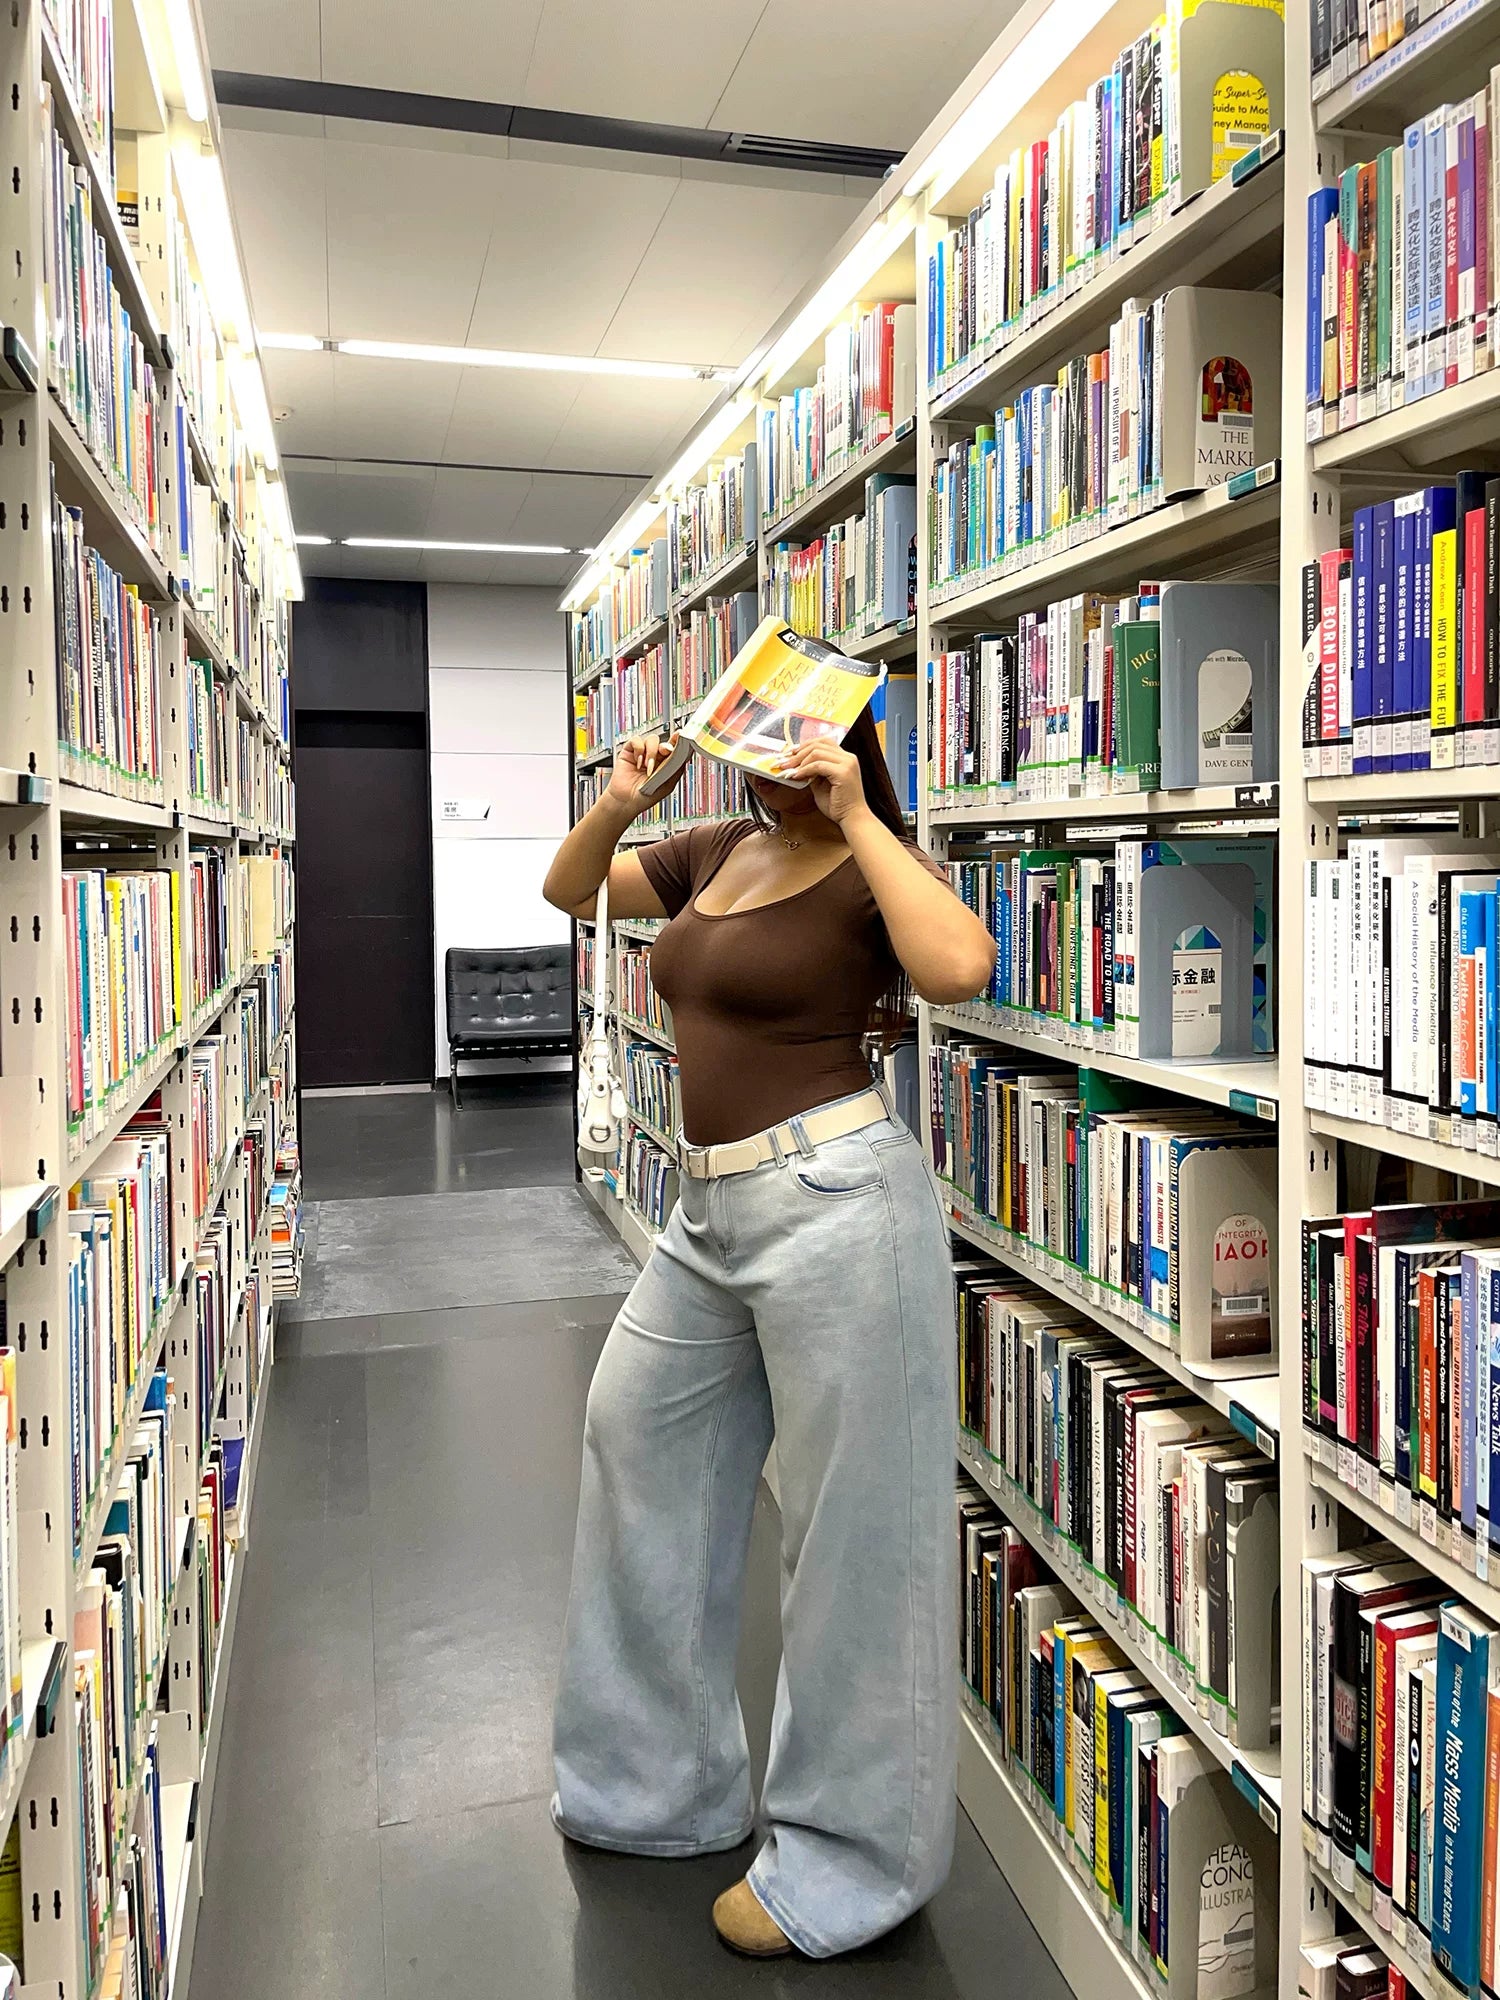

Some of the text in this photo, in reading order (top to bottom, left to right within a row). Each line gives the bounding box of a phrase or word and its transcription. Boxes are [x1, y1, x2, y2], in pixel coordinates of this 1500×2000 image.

[1153, 54, 1162, 126] DIY Super
[1407, 208, 1421, 308] 跨文化交际学选读
[1429, 198, 1442, 299] 跨文化交际学选读
[1447, 196, 1457, 267] 跨文化交际
[1112, 400, 1120, 433] PURSUIT
[1112, 437, 1120, 446] OF
[1221, 430, 1248, 445] THE
[1112, 450, 1120, 464] THE
[1205, 474, 1221, 486] AS
[1489, 516, 1495, 527] We
[1131, 648, 1157, 670] BIG
[1437, 618, 1447, 645] HOW
[1437, 647, 1447, 660] TO
[1322, 605, 1337, 733] BORN DIGITAL
[1437, 663, 1447, 679] FIX
[1437, 683, 1447, 702] THE
[1001, 674, 1010, 753] WILEY TRADING
[1412, 881, 1419, 889] A
[1069, 972, 1075, 980] IN
[1104, 912, 1112, 1004] THE ROAD TO RUIN
[1412, 972, 1419, 984] of
[1452, 930, 1460, 1080] INTRODUCTION TO DIGITAL MEDIA
[1460, 961, 1469, 1077] Twitter for Good
[1169, 1146, 1178, 1306] GLOBAL FINANCIAL WARRIORS
[1218, 1228, 1263, 1239] INTEGRITY
[1358, 1273, 1369, 1346] No Filter
[1464, 1271, 1472, 1328] Practical
[1337, 1302, 1346, 1409] Saving the Media
[1491, 1380, 1500, 1456] News Talk
[1157, 1506, 1163, 1520] Do
[1376, 1638, 1387, 1714] Confidential
[1452, 1663, 1463, 1728] History of the
[1081, 1728, 1090, 1827] STRESS TEST
[1360, 1685, 1368, 1837] AFTER BROADCAST NEWS
[1395, 1689, 1406, 1833] CAN JOURNALISM SURVIVE?
[1443, 1730, 1463, 1834] Mass Media
[1443, 1834, 1454, 1934] in the United States
